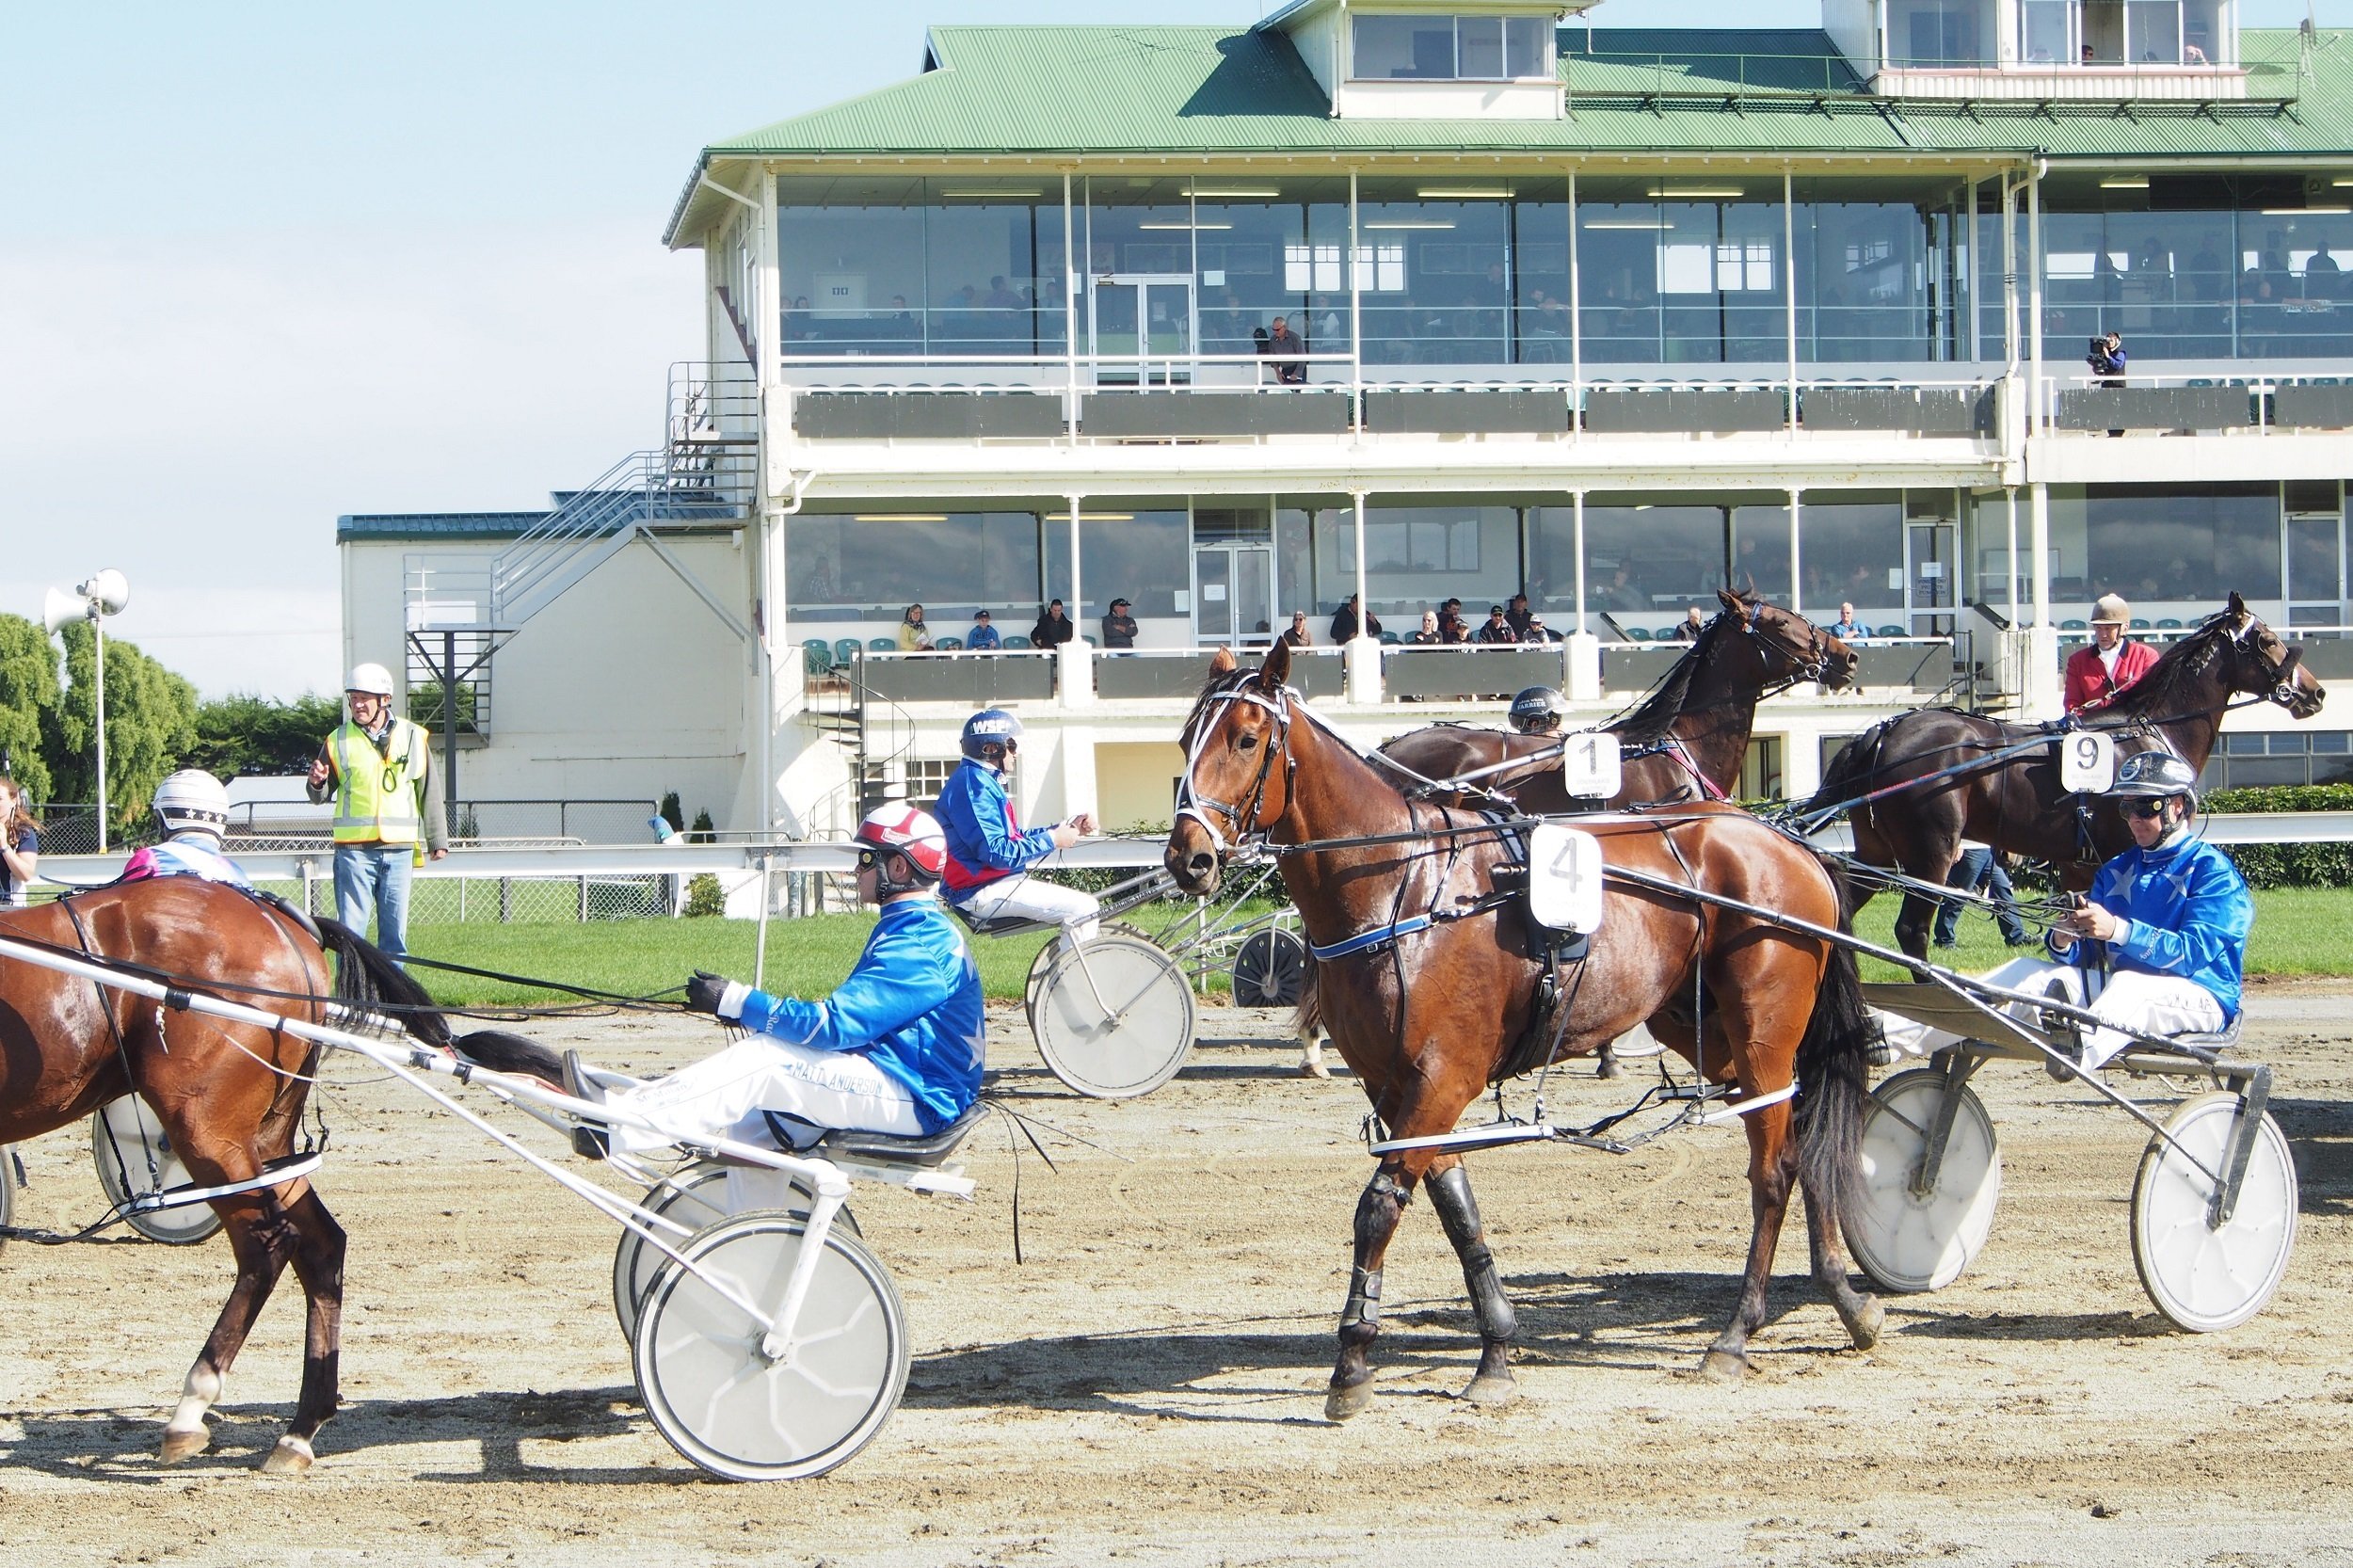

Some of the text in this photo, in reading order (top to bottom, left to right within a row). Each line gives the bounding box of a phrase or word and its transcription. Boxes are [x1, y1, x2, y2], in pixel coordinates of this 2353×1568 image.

[1517, 701, 1546, 711] FARRIER
[1578, 738, 1597, 776] 1
[2076, 736, 2099, 770] 9
[1549, 836, 1583, 894] 4
[1112, 899, 1134, 910] RACING
[1133, 888, 1158, 902] STABLES
[792, 1061, 883, 1095] MATT ANDERSON
